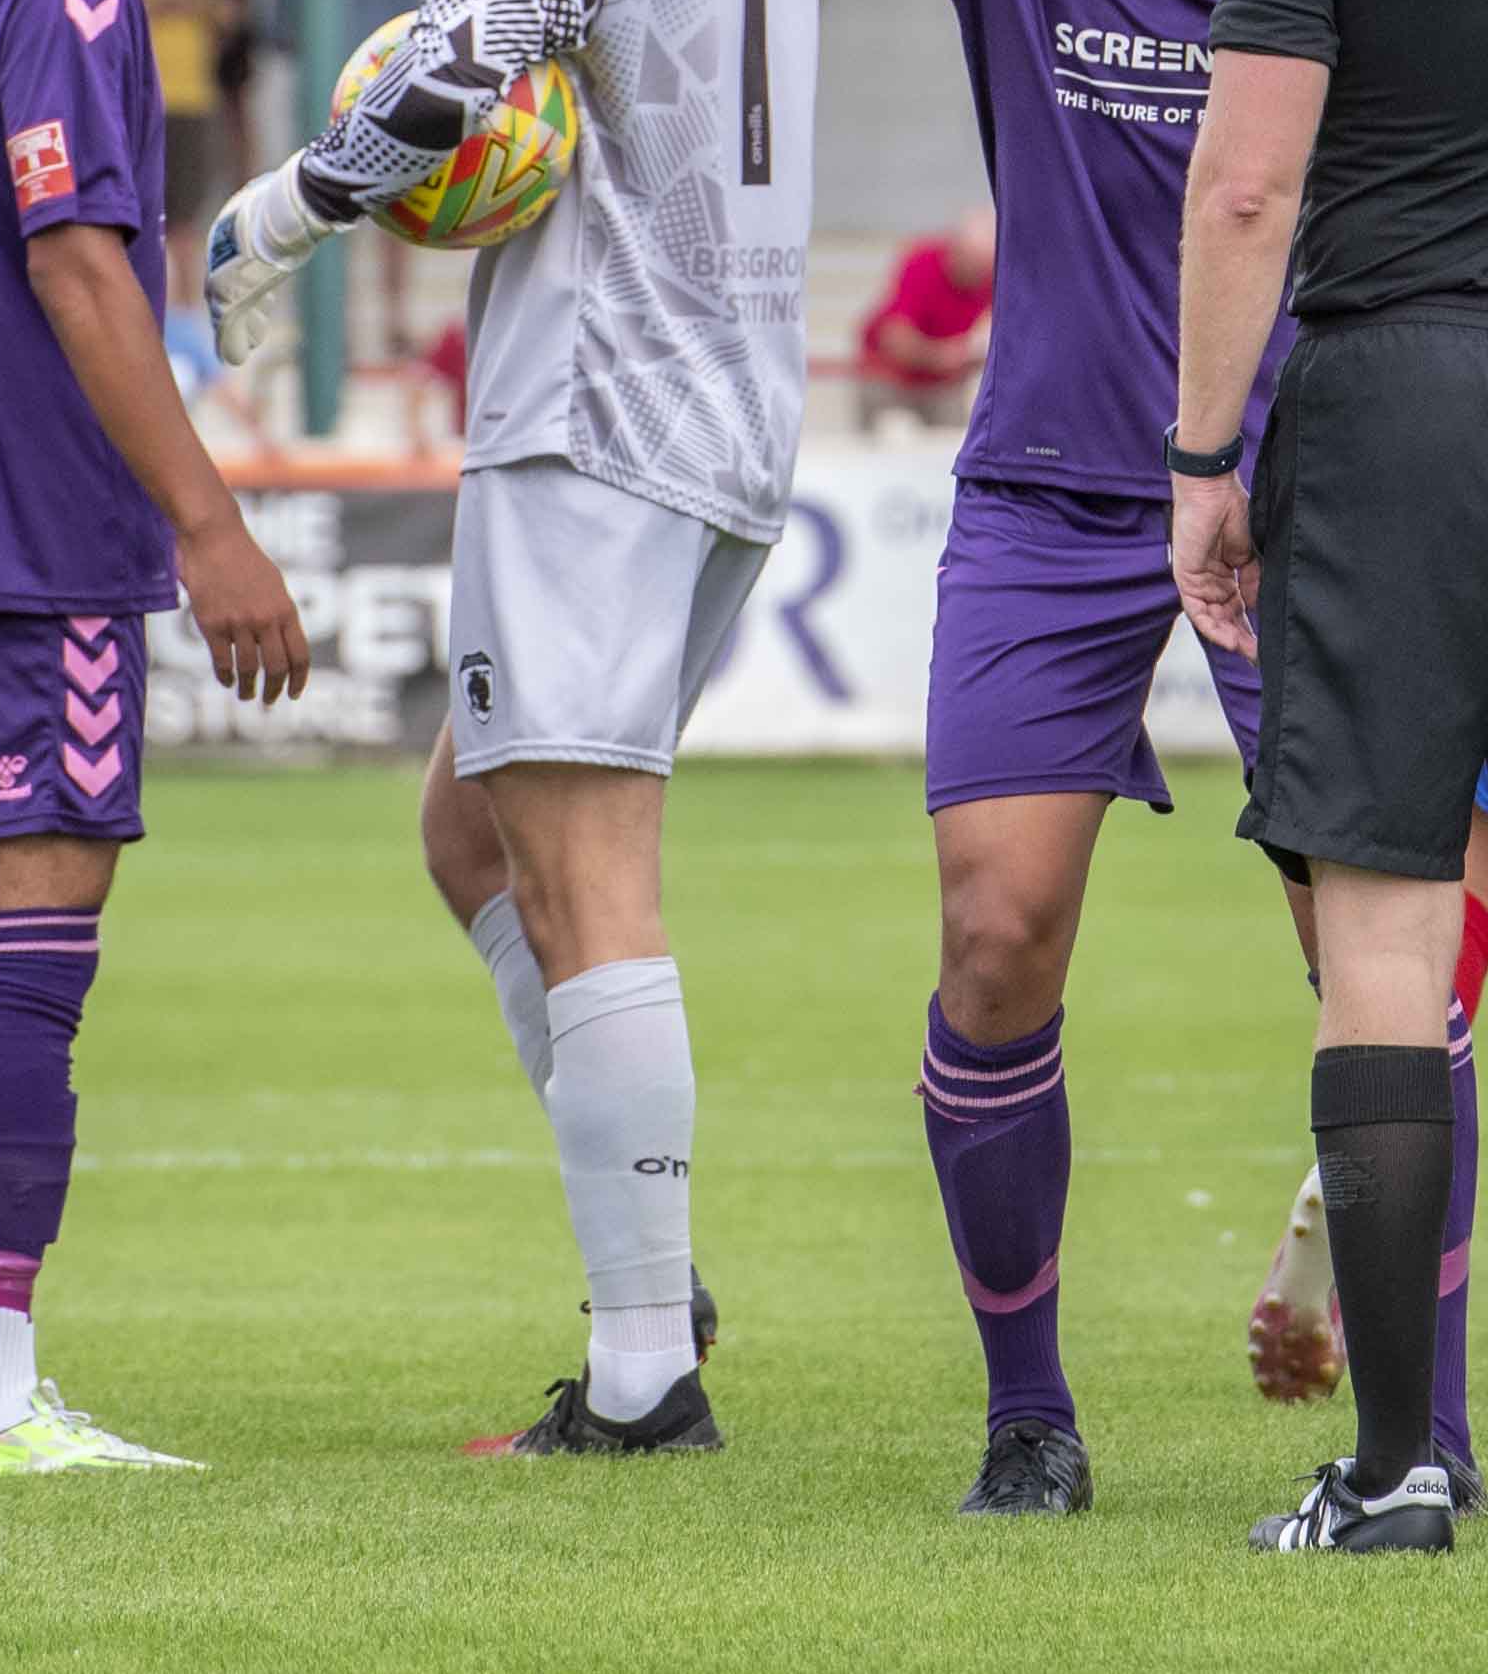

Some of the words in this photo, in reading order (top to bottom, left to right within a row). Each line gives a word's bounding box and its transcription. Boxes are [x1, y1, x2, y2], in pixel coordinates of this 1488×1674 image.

[1055, 89, 1087, 110] THE
[1092, 97, 1159, 122] FUTURE
[1164, 107, 1192, 123] OF
